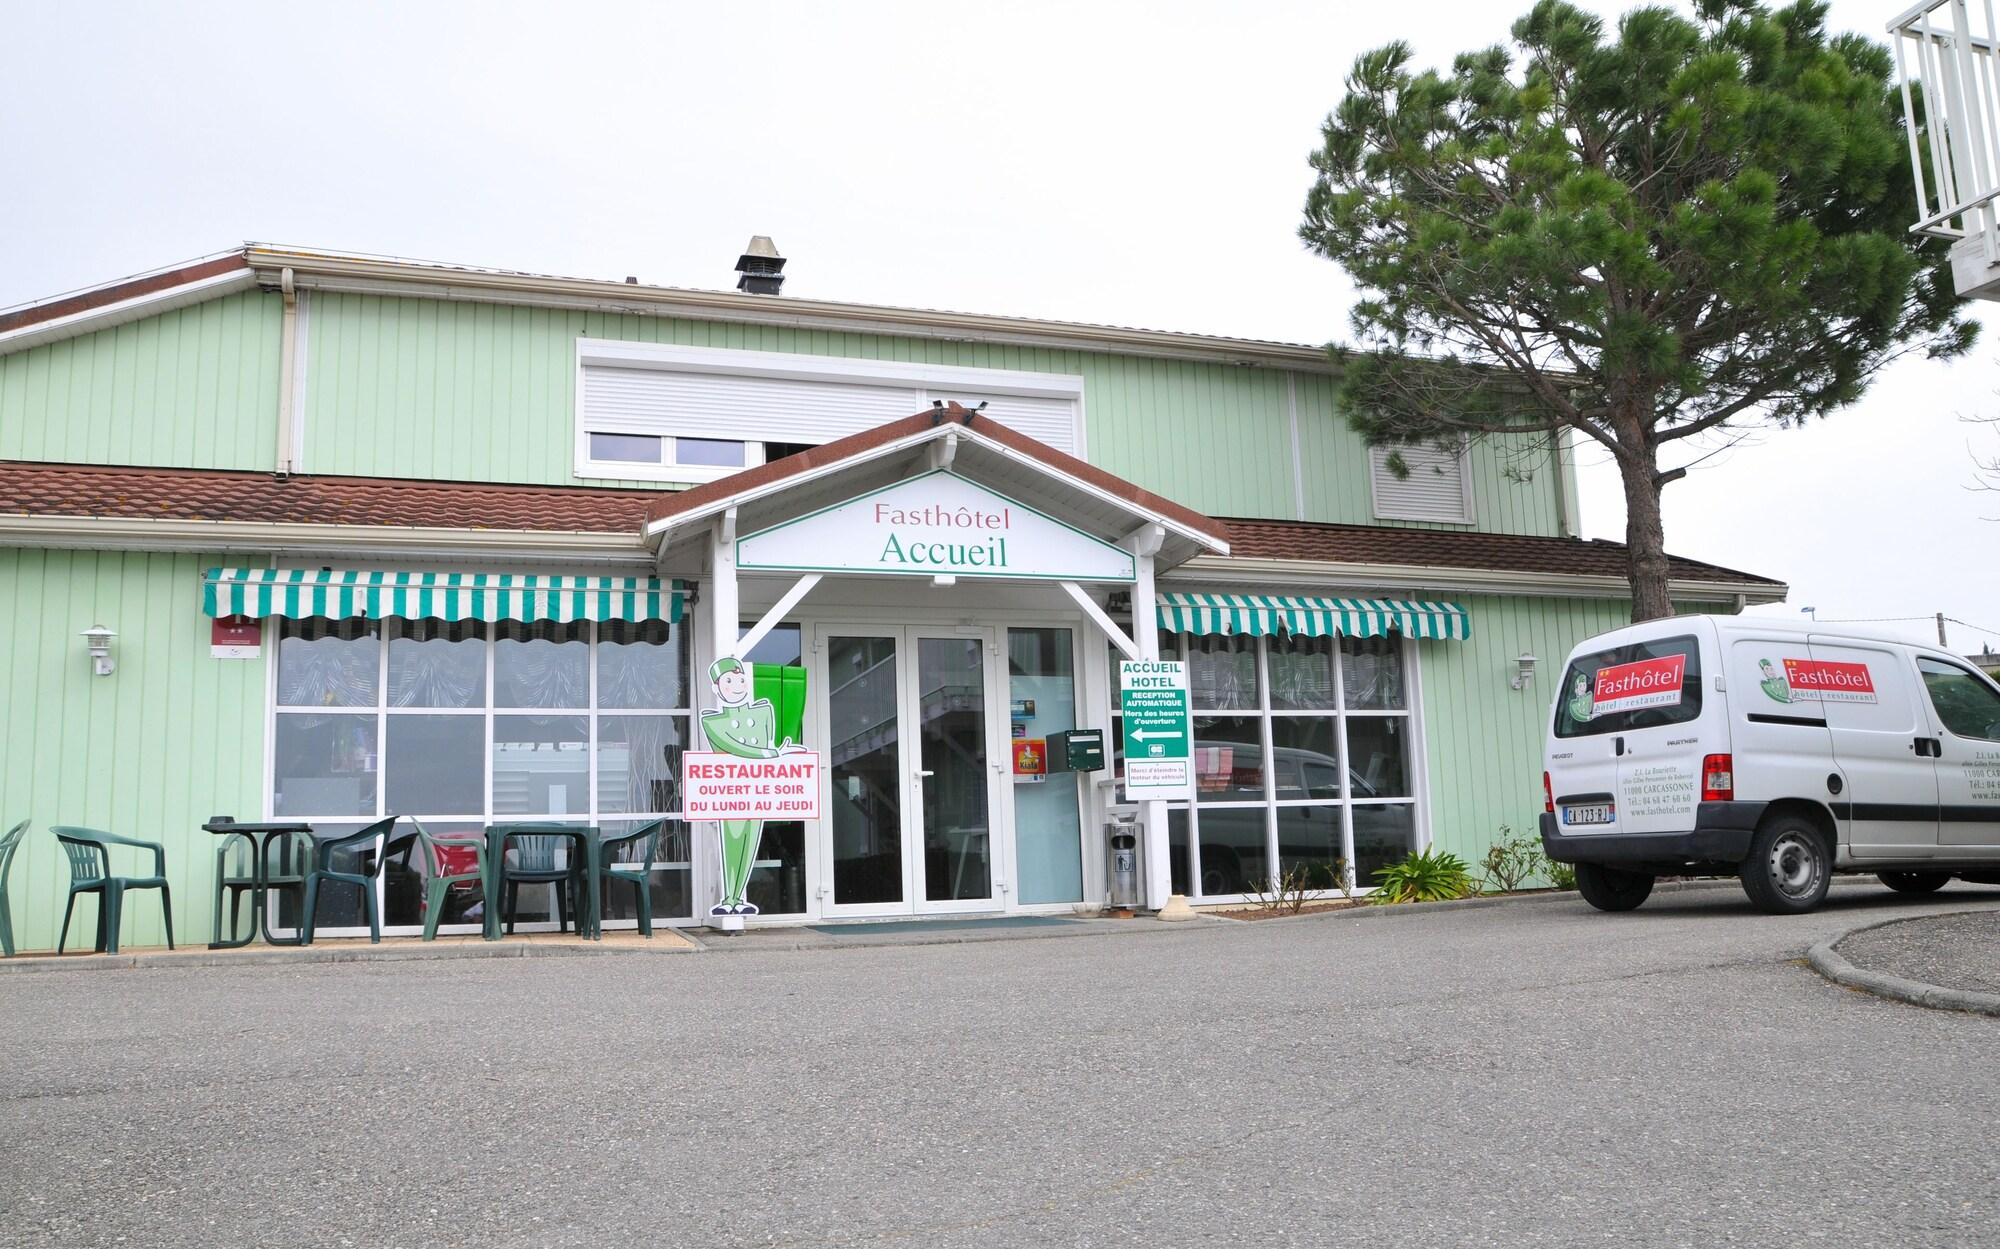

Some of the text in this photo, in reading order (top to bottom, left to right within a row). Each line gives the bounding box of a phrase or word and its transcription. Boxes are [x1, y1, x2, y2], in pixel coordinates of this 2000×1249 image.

[875, 503, 1010, 530] Fasthôtel
[879, 532, 1008, 567] Accueil
[1123, 663, 1182, 673] ACCUEIL
[1131, 677, 1176, 687] HOTEL
[1597, 664, 1680, 696] Fasthôtel
[1788, 667, 1869, 687] Fasthôtel
[1594, 693, 1677, 712] hôtel restaurant
[1793, 690, 1873, 701] hôtel restaurant
[688, 764, 815, 779] RESTAURANT
[699, 785, 804, 795] OUVERT LE SOIR
[1624, 782, 1694, 796] 11000 CARCASSONNE
[690, 801, 813, 811] DU LUNDI AU JEUDI
[1631, 805, 1691, 816] www.fasthotel.com
